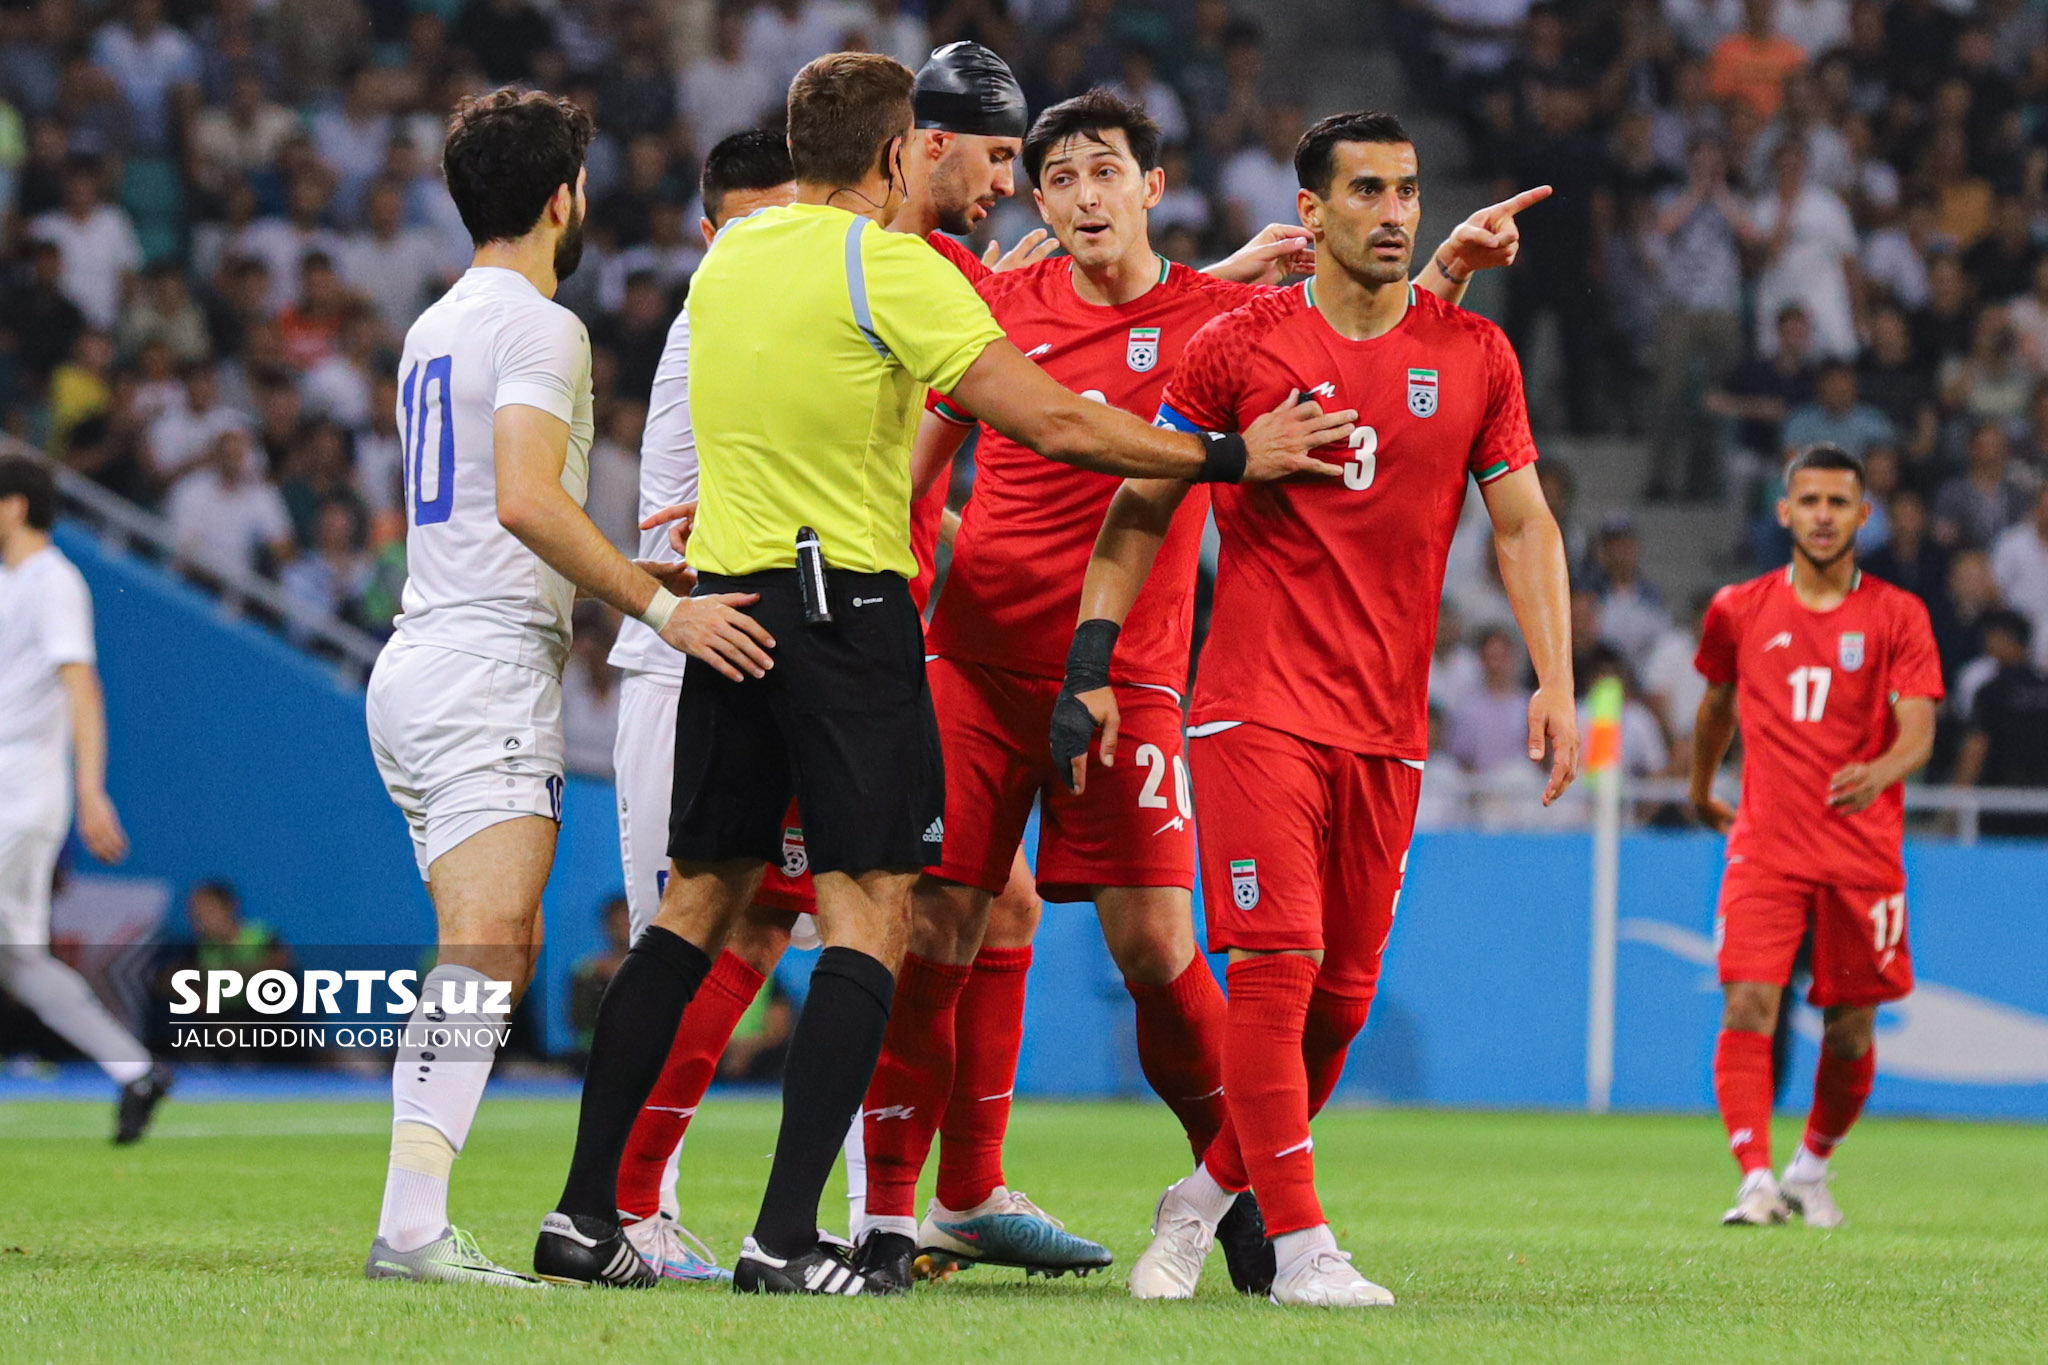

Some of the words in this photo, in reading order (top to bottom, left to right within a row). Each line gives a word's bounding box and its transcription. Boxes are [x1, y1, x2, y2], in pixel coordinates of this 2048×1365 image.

[403, 355, 454, 526] 10
[1343, 425, 1378, 491] 3
[1787, 665, 1832, 722] 17
[1135, 743, 1192, 820] 20
[1869, 892, 1905, 952] 17
